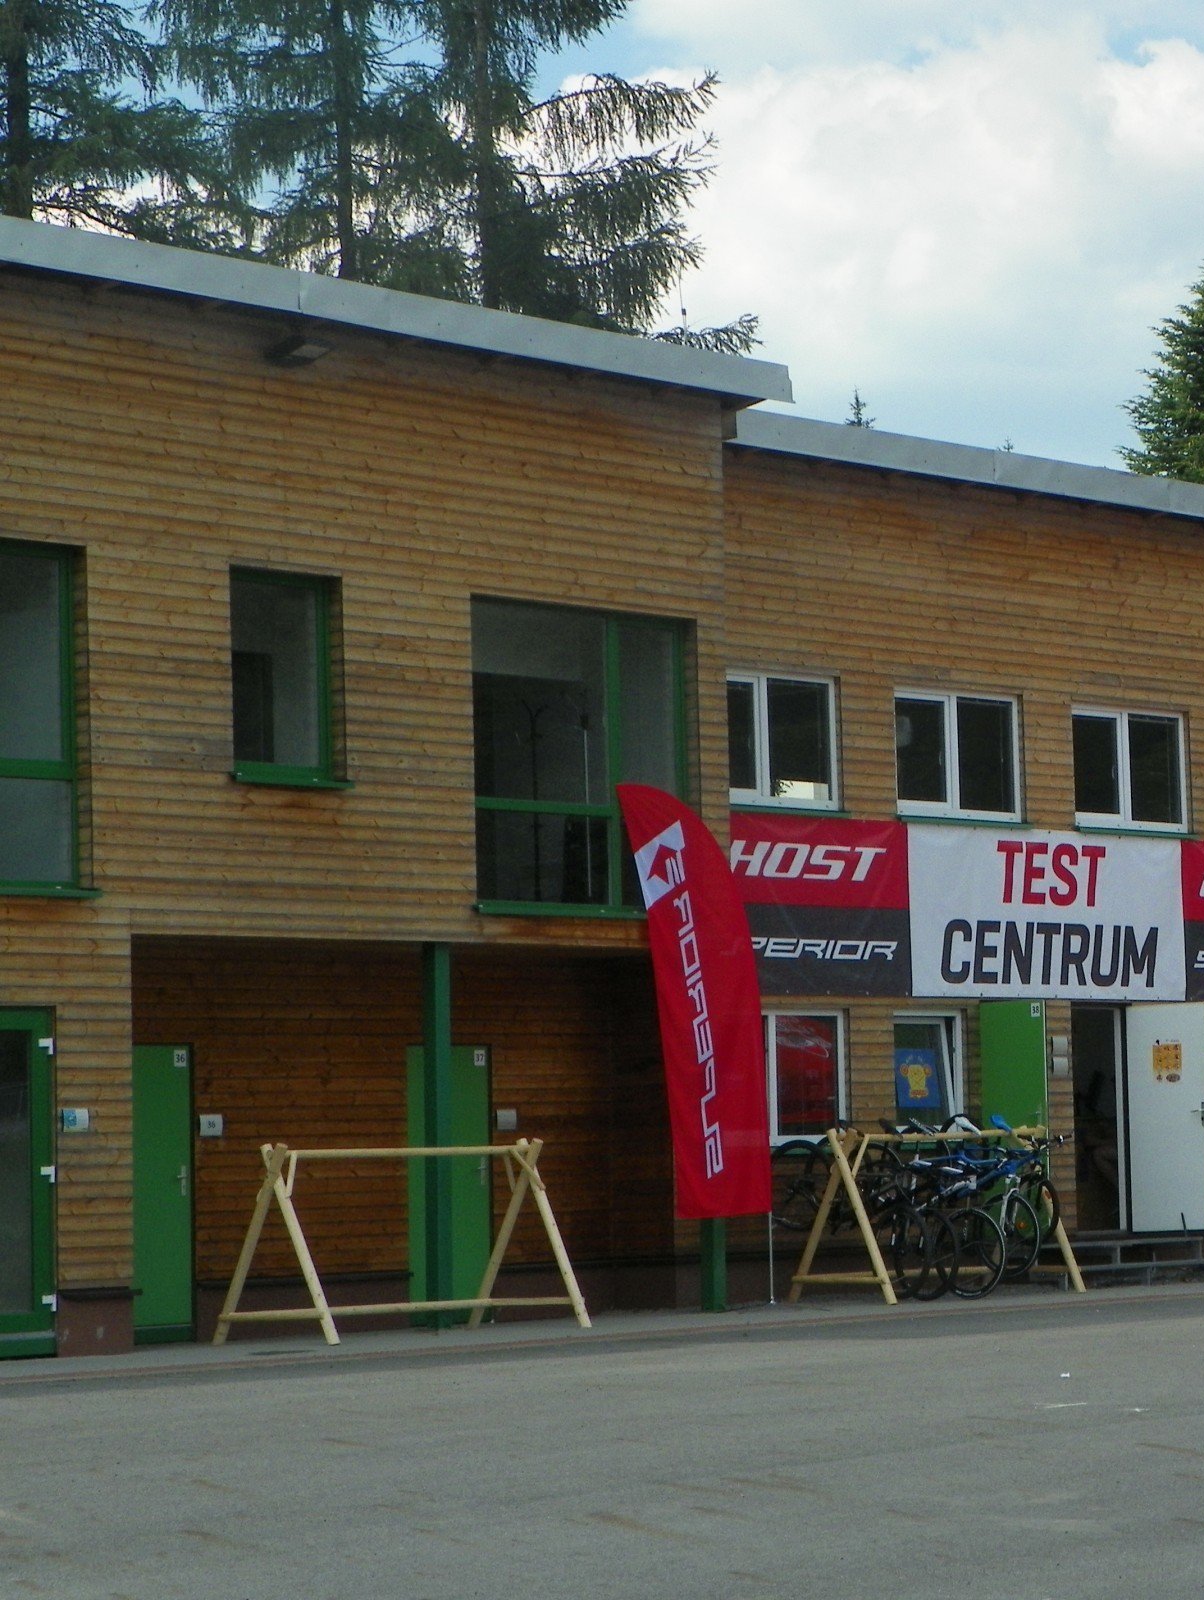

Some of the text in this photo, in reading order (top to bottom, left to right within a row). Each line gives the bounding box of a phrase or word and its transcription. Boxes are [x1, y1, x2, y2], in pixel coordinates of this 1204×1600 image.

[730, 839, 887, 882] HOST
[997, 840, 1106, 907] TEST
[751, 936, 898, 961] PERIOR
[940, 918, 1159, 988] CENTRUM
[1032, 1005, 1040, 1014] 38
[175, 1053, 186, 1063] 36
[475, 1053, 484, 1063] 37
[207, 1120, 216, 1129] 36
